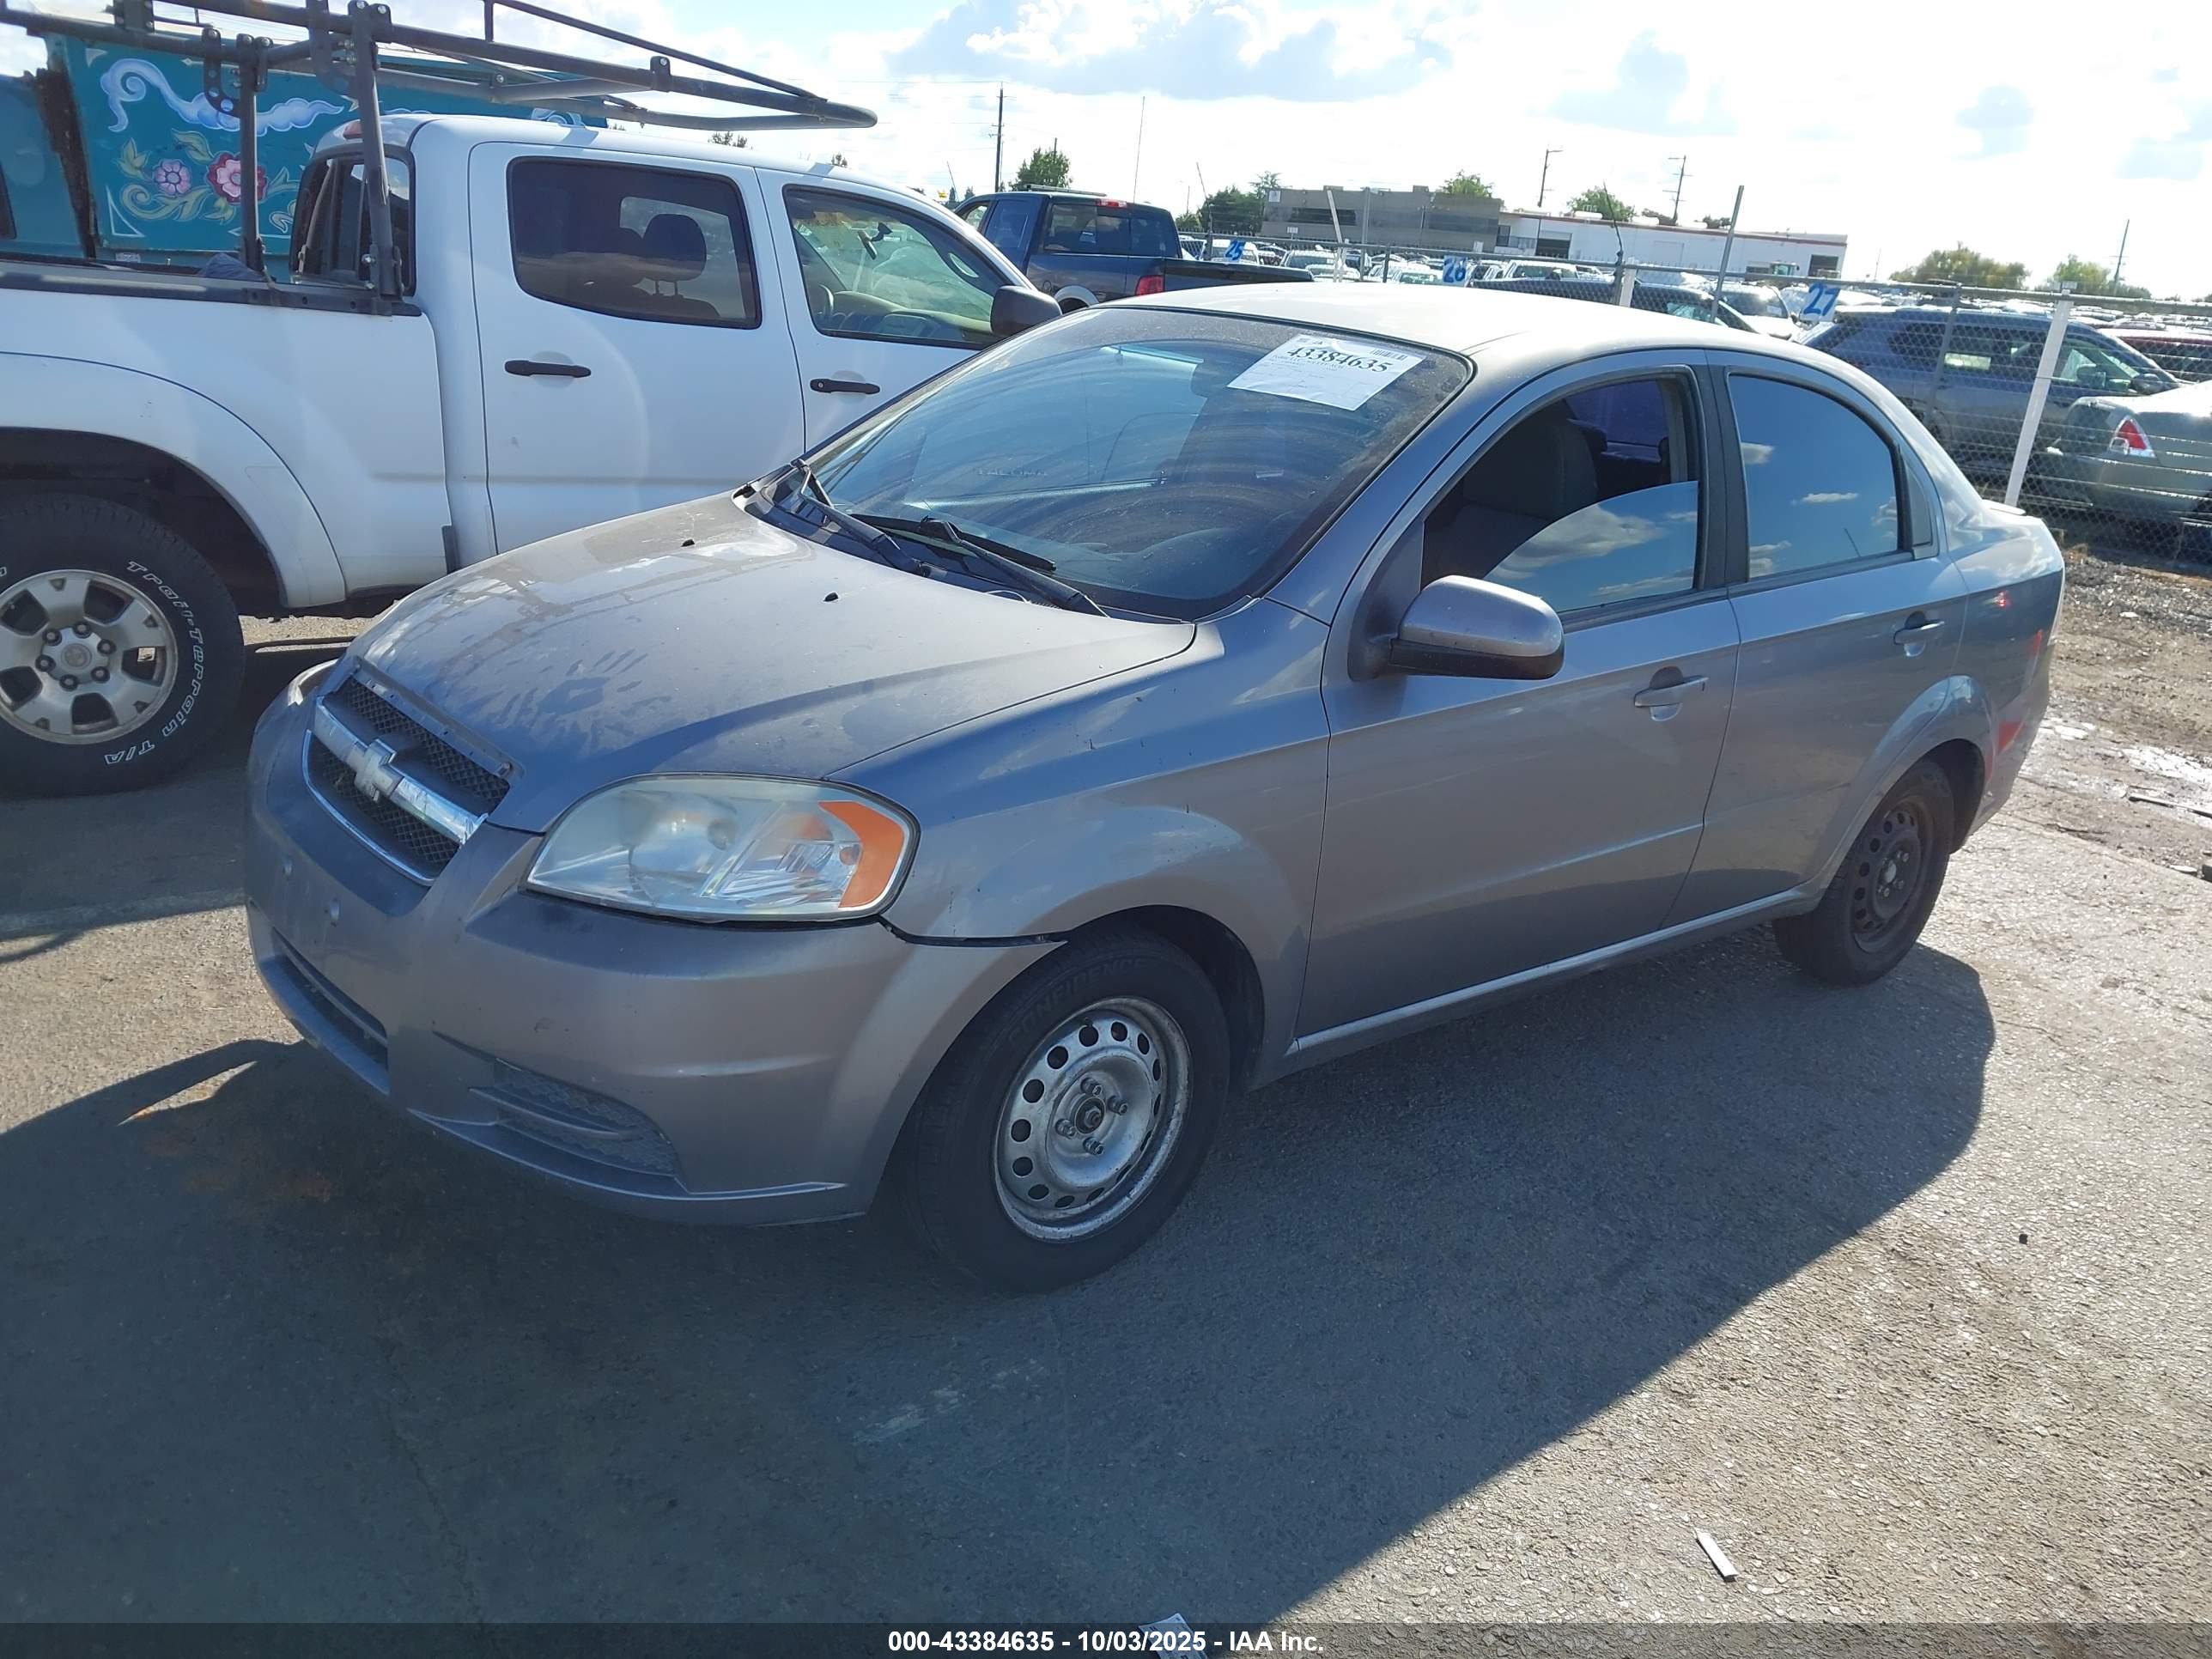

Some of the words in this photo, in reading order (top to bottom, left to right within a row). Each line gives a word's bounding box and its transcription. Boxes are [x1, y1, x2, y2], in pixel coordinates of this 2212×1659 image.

[1224, 240, 1245, 261] 25
[1443, 258, 1467, 283] 26
[1803, 282, 1841, 316] 27
[1286, 347, 1393, 373] 43384635
[103, 739, 156, 766] T/A
[1008, 957, 1149, 1045] CONFIDENCE
